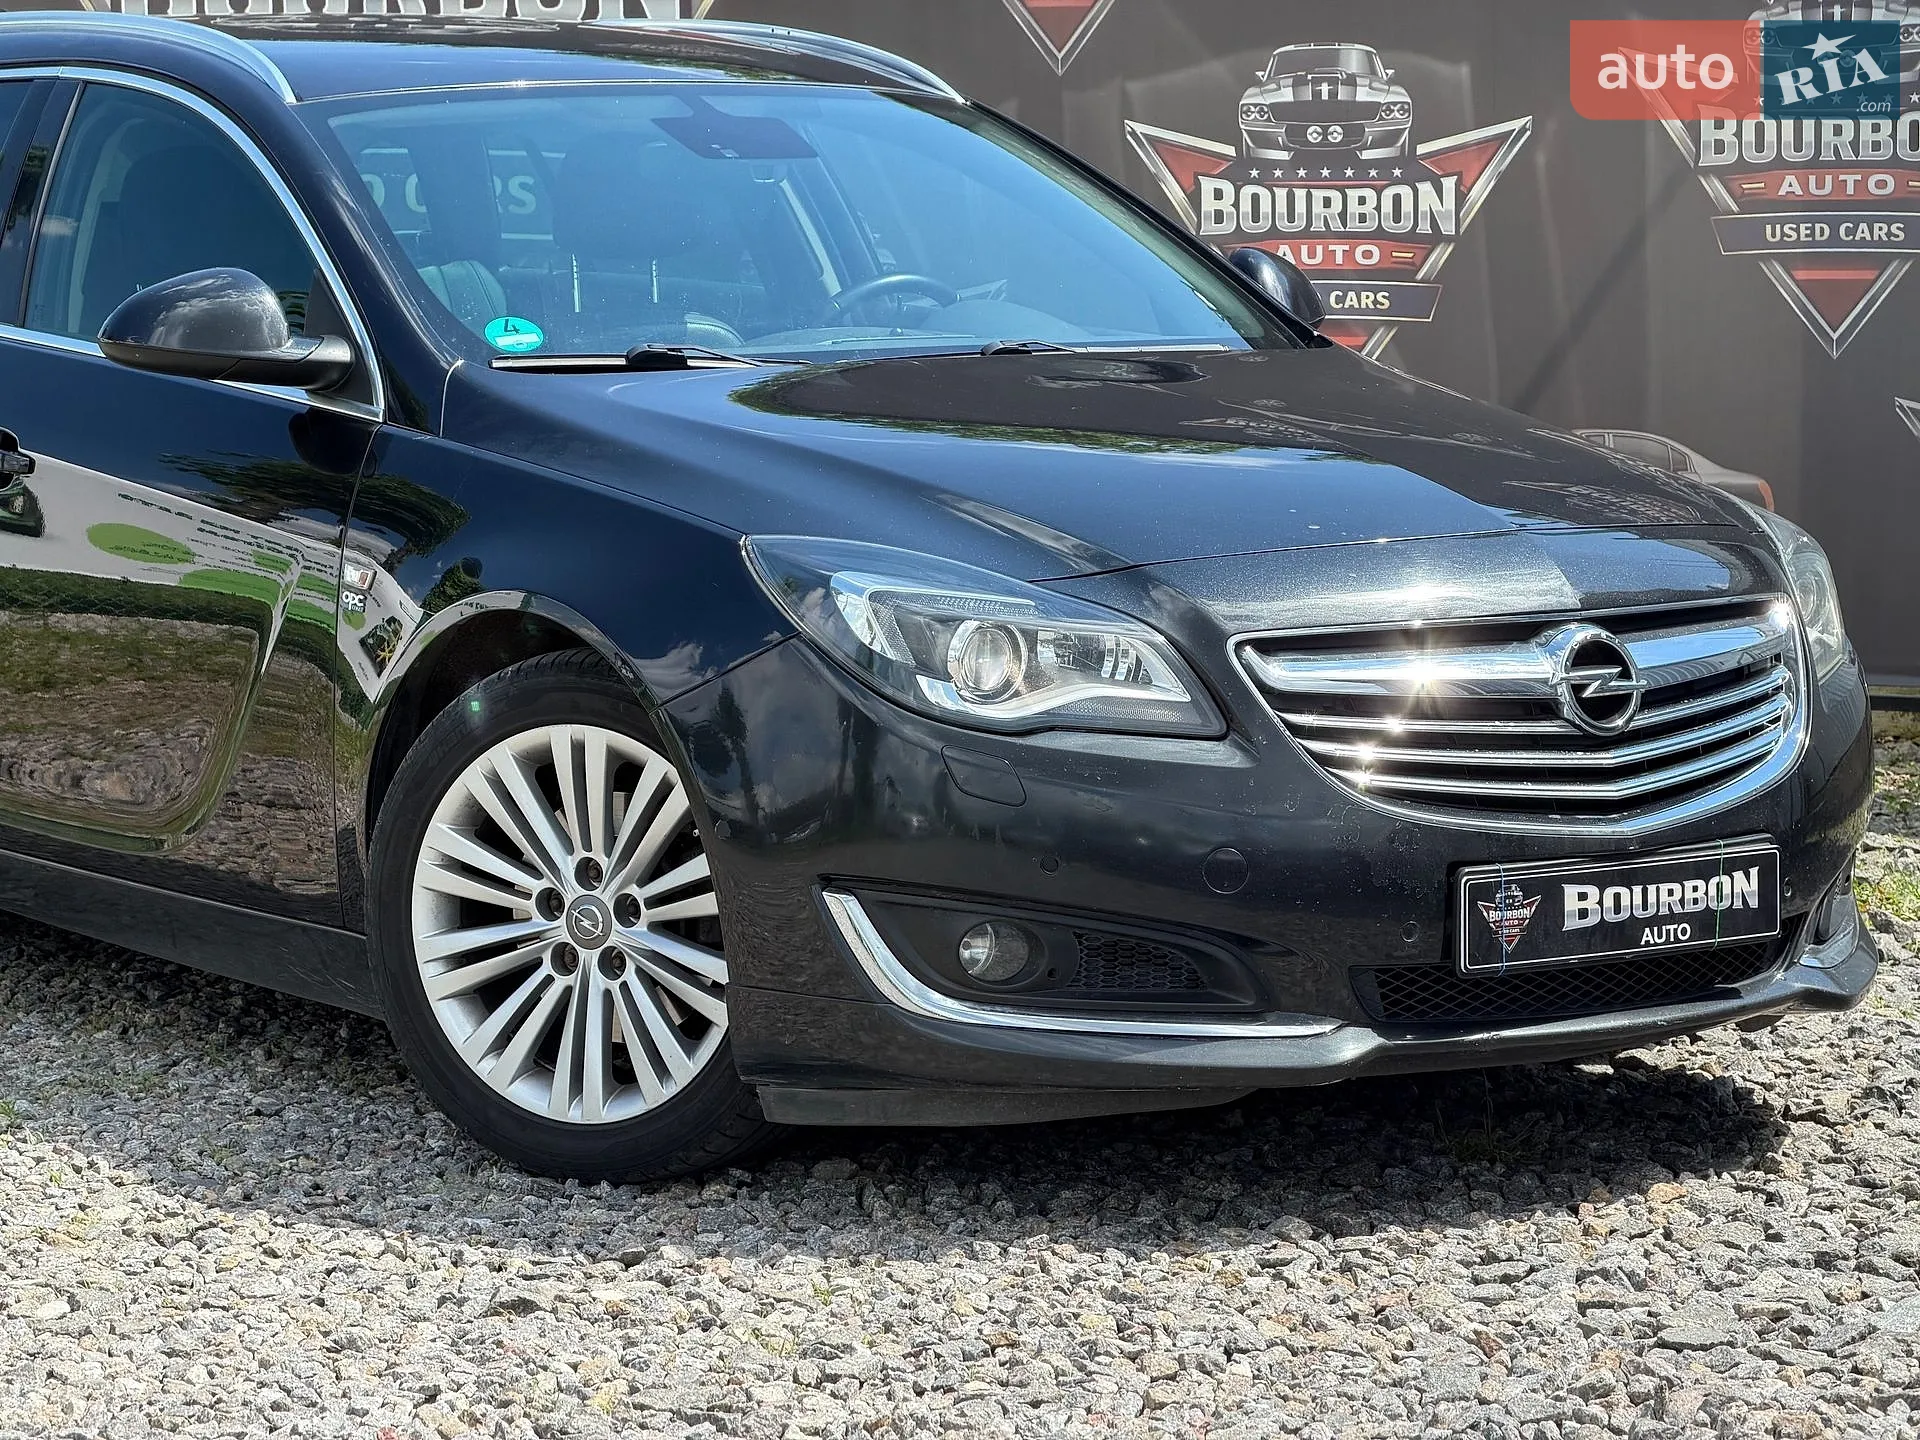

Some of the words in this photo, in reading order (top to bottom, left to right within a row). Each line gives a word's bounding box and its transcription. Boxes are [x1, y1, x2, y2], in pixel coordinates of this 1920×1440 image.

[1777, 173, 1895, 196] AUTO
[1198, 175, 1458, 236] BOURBON
[1765, 222, 1831, 242] USED
[1838, 221, 1906, 242] CARS
[1329, 290, 1391, 310] CARS
[1561, 866, 1760, 932] BOURBON
[1640, 922, 1692, 946] AUTO
